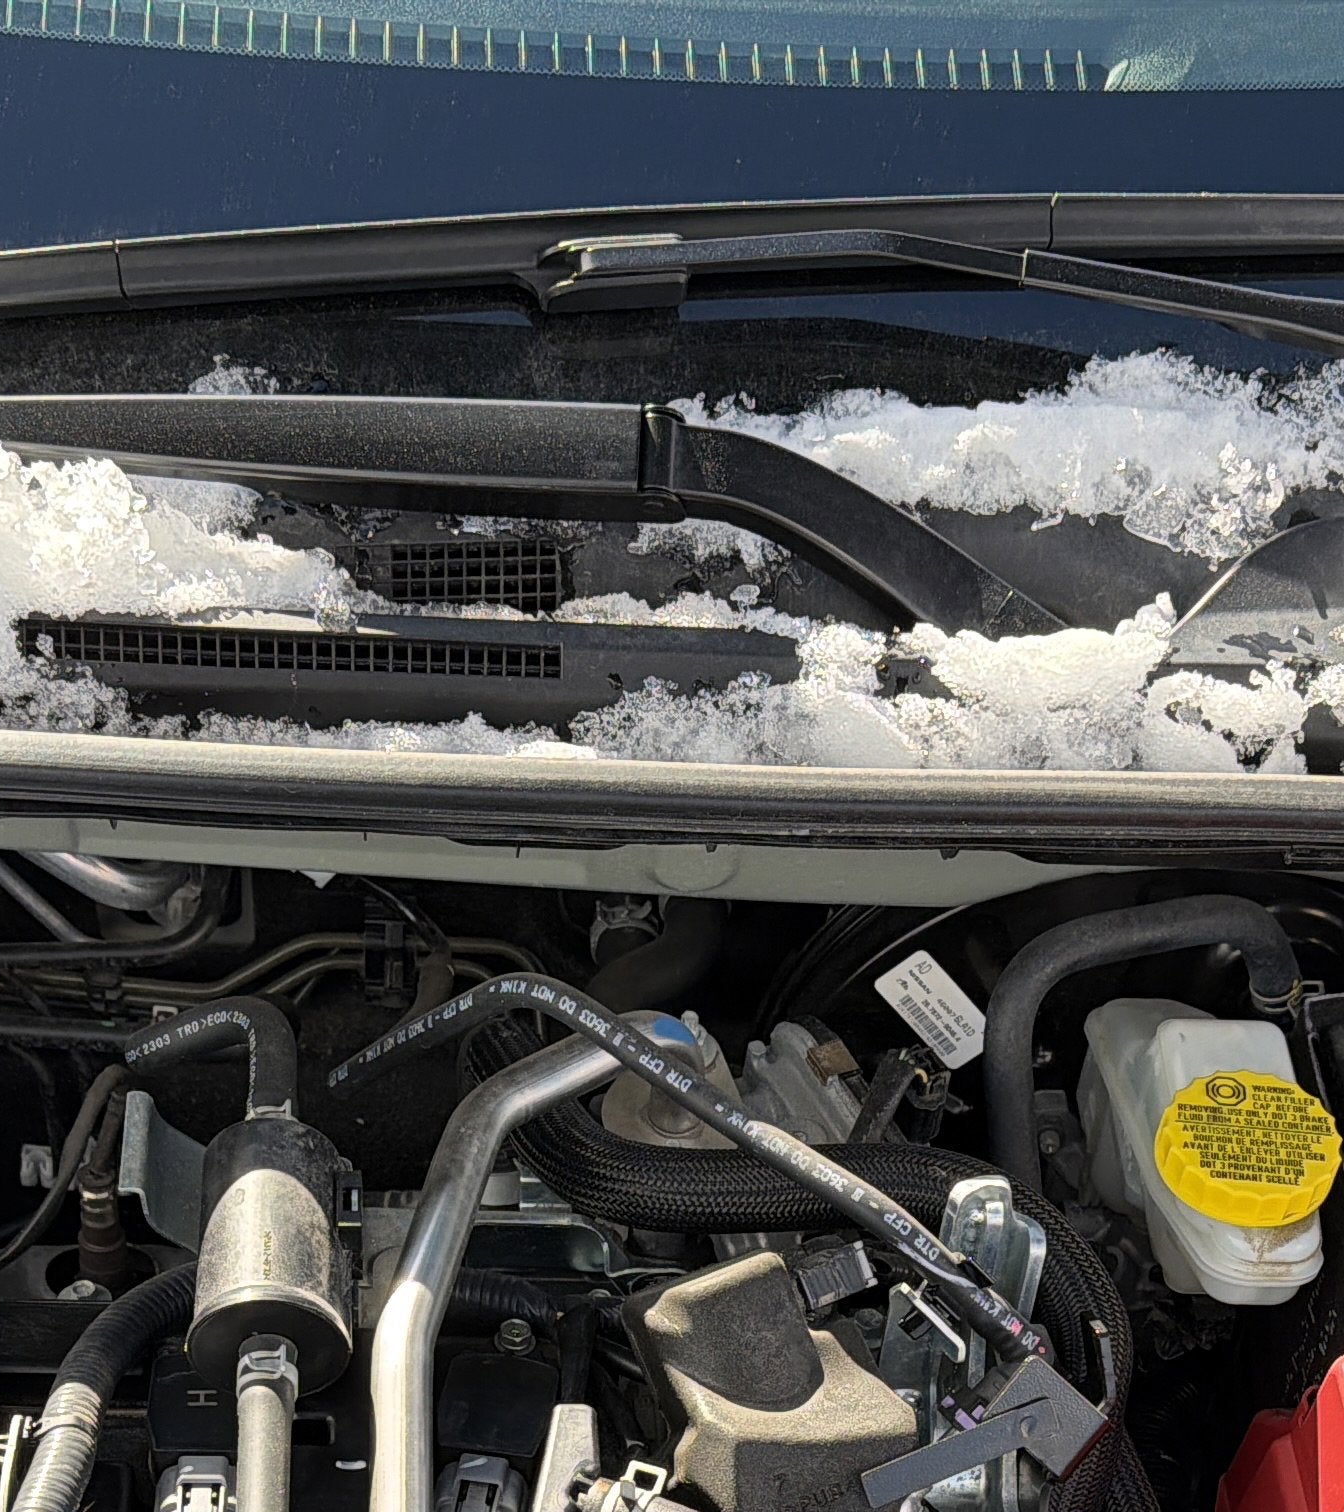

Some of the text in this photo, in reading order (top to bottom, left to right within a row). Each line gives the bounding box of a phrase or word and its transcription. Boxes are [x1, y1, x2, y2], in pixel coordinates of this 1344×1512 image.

[915, 961, 932, 975] AD
[664, 1067, 693, 1094] DTR
[1253, 1102, 1310, 1114] CAP BEFORE
[1285, 1097, 1315, 1106] FILLER
[1178, 1113, 1203, 1121] FLUID
[1207, 1114, 1231, 1124] FROM
[1244, 1118, 1279, 1128] SEALED
[1228, 1108, 1244, 1117] USE
[1246, 1110, 1268, 1118] ONLY
[1272, 1112, 1288, 1120] DOT
[1300, 1115, 1329, 1124] BRAKE
[1183, 1141, 1215, 1151] AVANT
[1218, 1144, 1228, 1152] DE
[1194, 1134, 1312, 1151] BOUCHON DE REMPLISSAGE
[1200, 1160, 1216, 1168] DOT
[1228, 1163, 1281, 1174] PROVENANT
[1256, 1156, 1267, 1164] DU
[1270, 1157, 1304, 1168] LIQUIDE
[1210, 1170, 1263, 1182] CONTENANT
